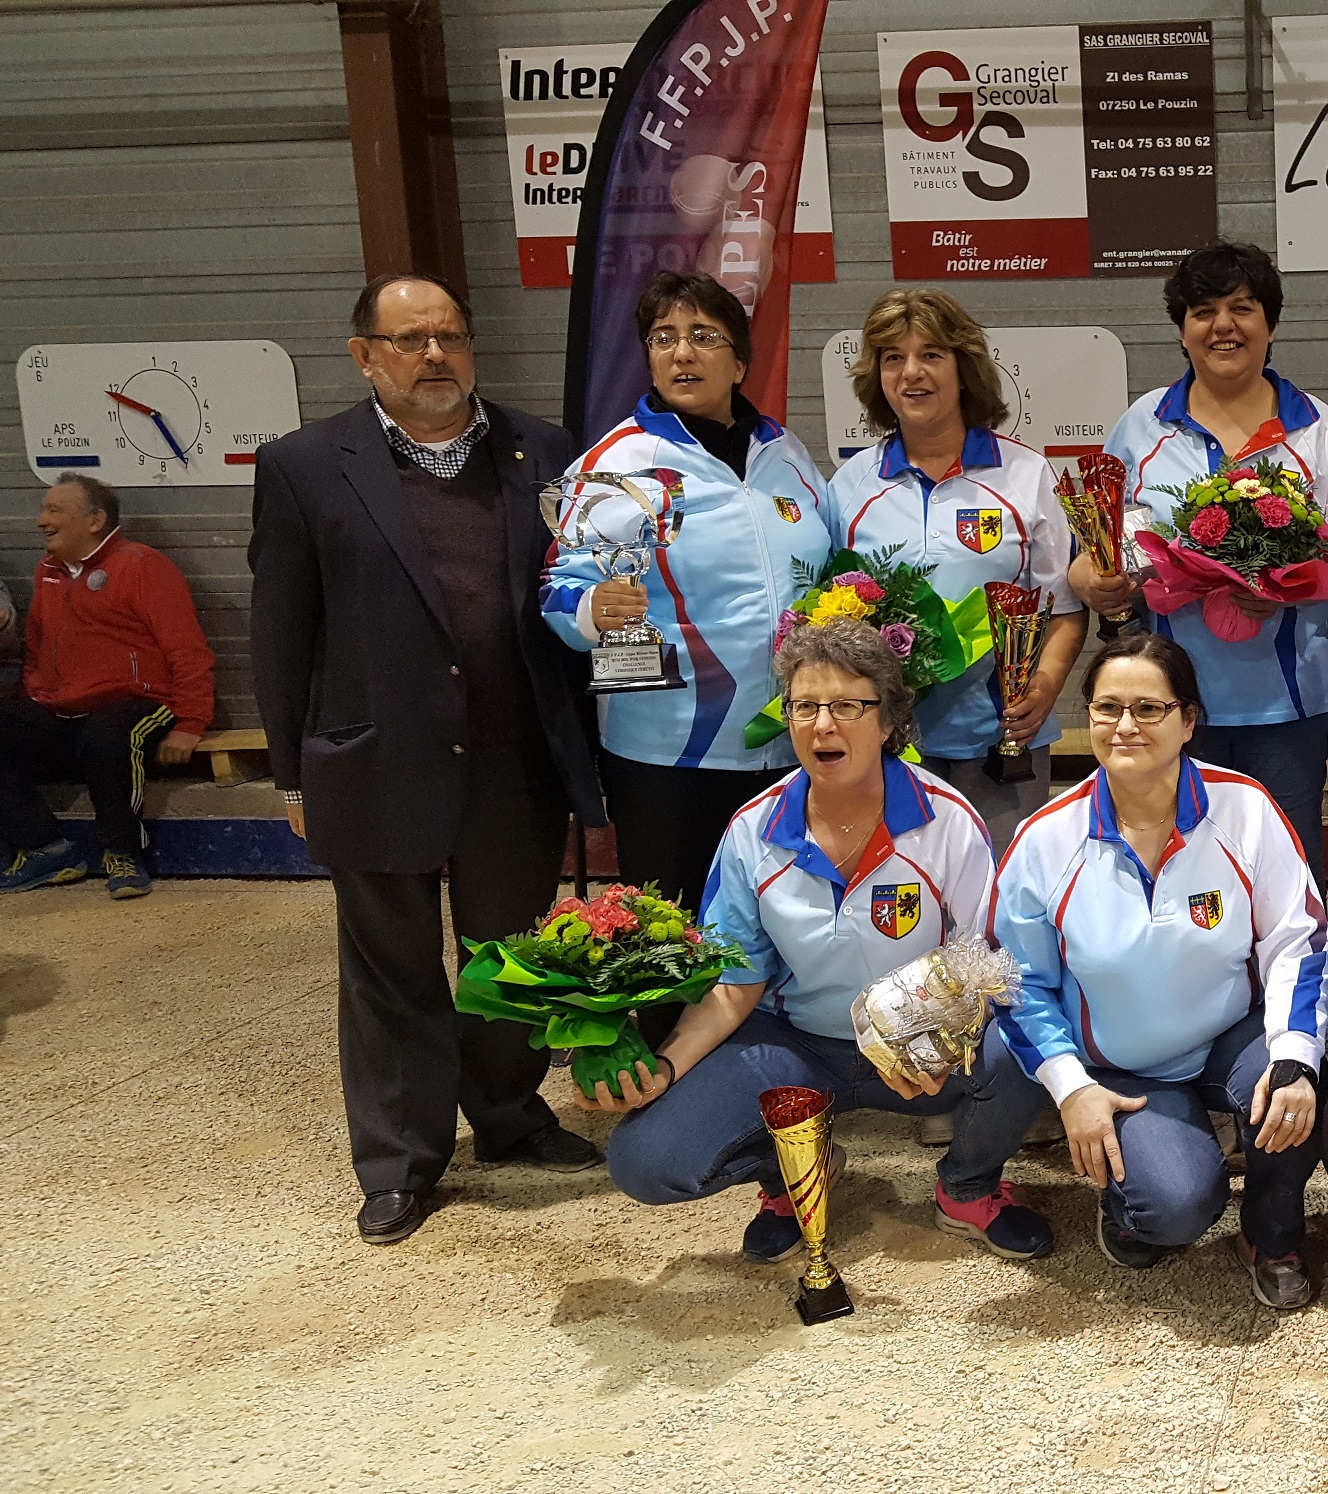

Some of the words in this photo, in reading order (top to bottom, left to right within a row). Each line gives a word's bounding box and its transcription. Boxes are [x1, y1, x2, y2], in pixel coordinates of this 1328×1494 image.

[1084, 35, 1104, 47] SAS
[1106, 33, 1160, 47] GRANGIER
[1162, 31, 1209, 45] SECOVAL
[975, 61, 1069, 87] Grangier
[1106, 72, 1119, 82] ZI
[1122, 71, 1144, 81] des
[1148, 70, 1188, 81] Ramas
[977, 83, 1058, 106] Secoval
[1099, 99, 1136, 111] 07250
[1140, 99, 1155, 109] Le
[1158, 98, 1198, 109] Pouzin
[1091, 138, 1115, 150] Tel:
[1117, 138, 1134, 149] 04
[1137, 138, 1153, 149] 75
[1156, 137, 1172, 148] 63
[1175, 136, 1191, 148] 80
[1194, 136, 1211, 147] 62
[525, 142, 594, 176] leD
[902, 151, 955, 161] BÂTIMENT
[910, 165, 957, 175] TRAVAUX
[1091, 168, 1118, 179] Fax:
[1120, 167, 1137, 178] 04
[1140, 167, 1156, 178] 75
[1158, 166, 1175, 177] 63
[1178, 166, 1194, 177] 95
[1197, 165, 1213, 176] 22
[914, 179, 958, 189] PUBLICS
[932, 230, 972, 246] Bâtir
[959, 246, 978, 257] est
[1102, 248, 1196, 258] ent.grangier@wanado
[946, 257, 991, 272] notre
[993, 255, 1048, 272] métier
[834, 342, 858, 354] JEU
[993, 348, 1000, 360] 2
[27, 356, 48, 368] JEU
[152, 356, 156, 367] 1
[171, 361, 179, 373] 2
[844, 357, 850, 369] 5
[36, 371, 42, 382] 6
[1013, 364, 1020, 377] 3
[191, 376, 198, 388] 3
[1024, 388, 1031, 400] 4
[203, 399, 209, 410] 4
[108, 411, 117, 422] 11
[1024, 412, 1031, 425] 5
[53, 423, 75, 435] APS
[205, 422, 212, 434] 5
[845, 428, 857, 437] LE
[1054, 424, 1104, 437] VISITEUR
[42, 437, 53, 448] LE
[58, 437, 90, 448] POUZIN
[115, 437, 126, 449] 10
[197, 443, 203, 454] 6
[138, 455, 145, 466] 9
[160, 461, 167, 472] 8
